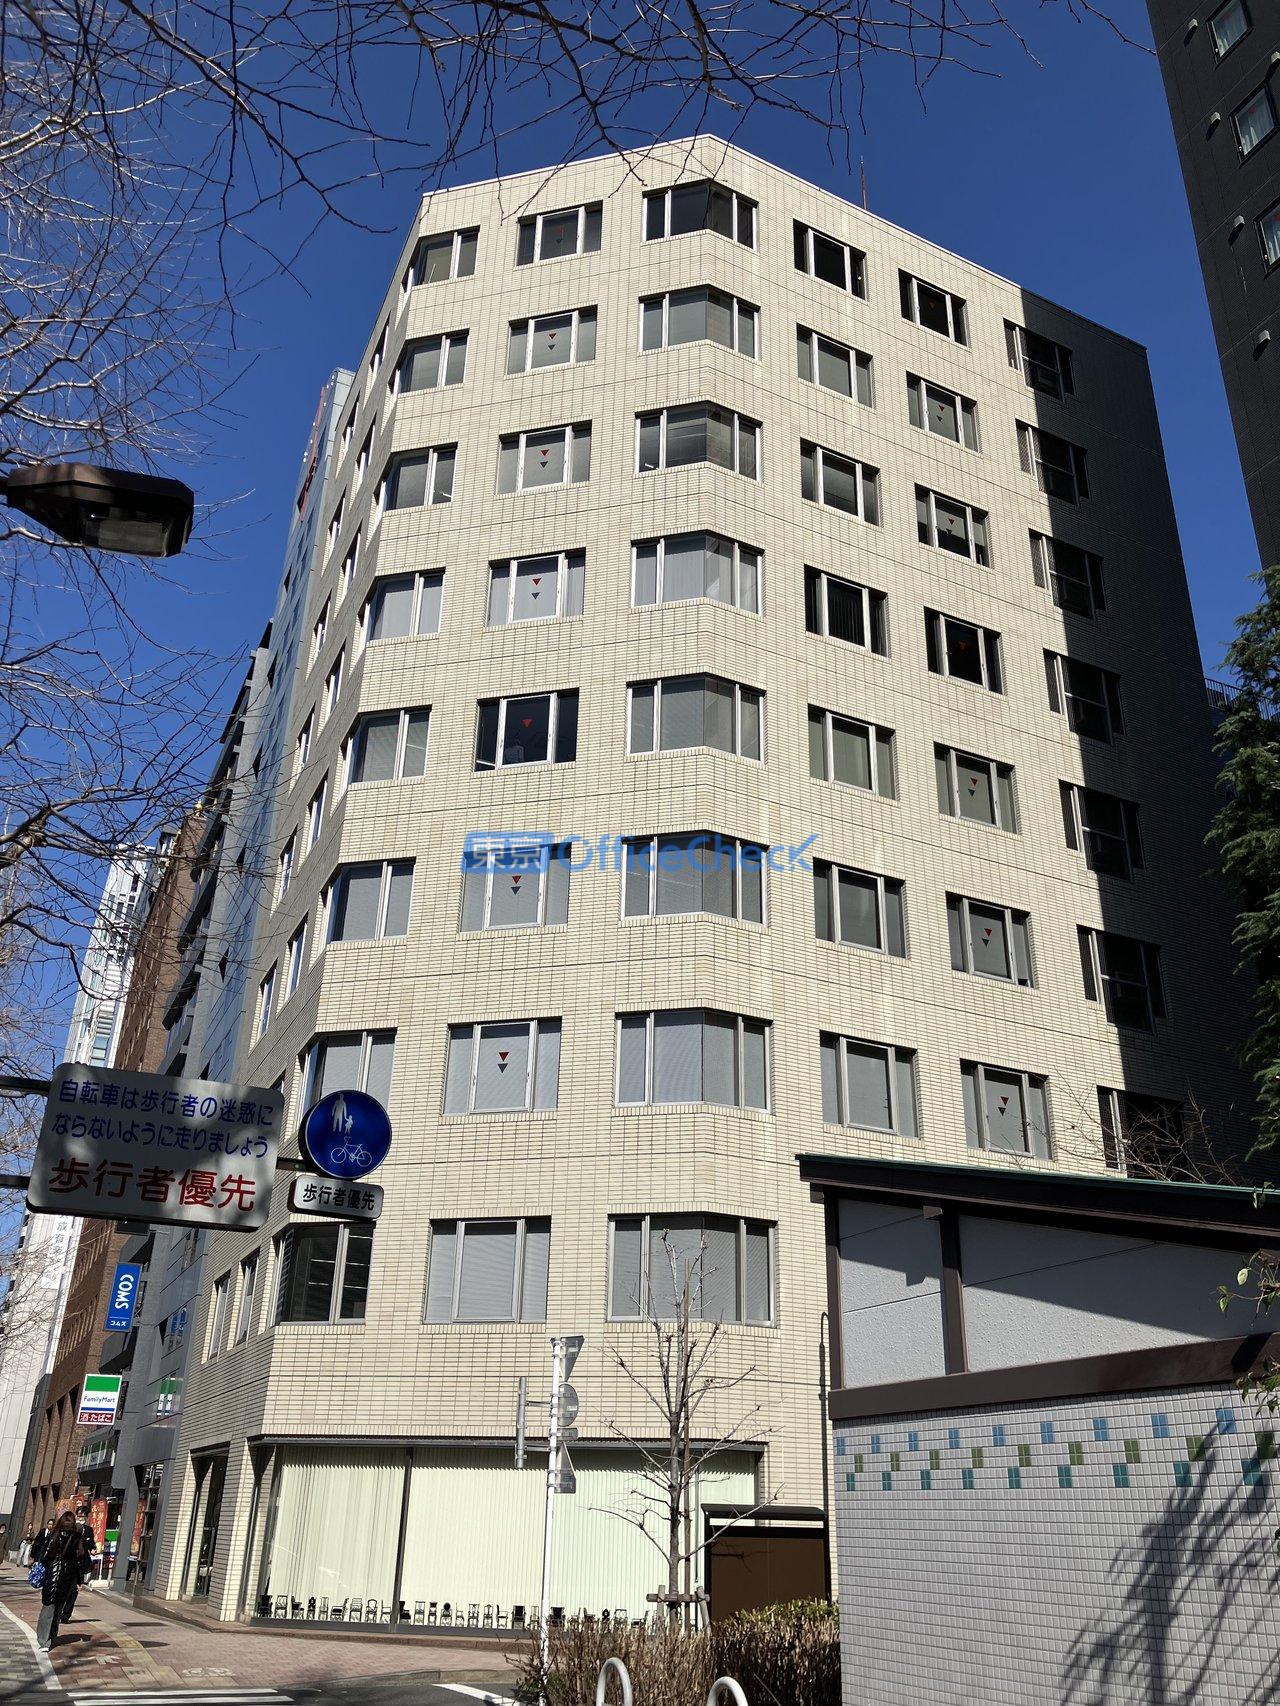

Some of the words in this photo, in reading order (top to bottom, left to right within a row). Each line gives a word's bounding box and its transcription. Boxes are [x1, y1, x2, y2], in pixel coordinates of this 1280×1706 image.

[59, 1078, 273, 1127] 自転車は歩行者の迷惑に
[52, 1111, 269, 1159] ならないように走りましょう
[48, 1158, 256, 1212] 歩行者優先
[303, 1183, 375, 1211] 歩行者優先
[114, 1274, 134, 1309] COMS
[83, 1395, 116, 1404] FamilyMart
